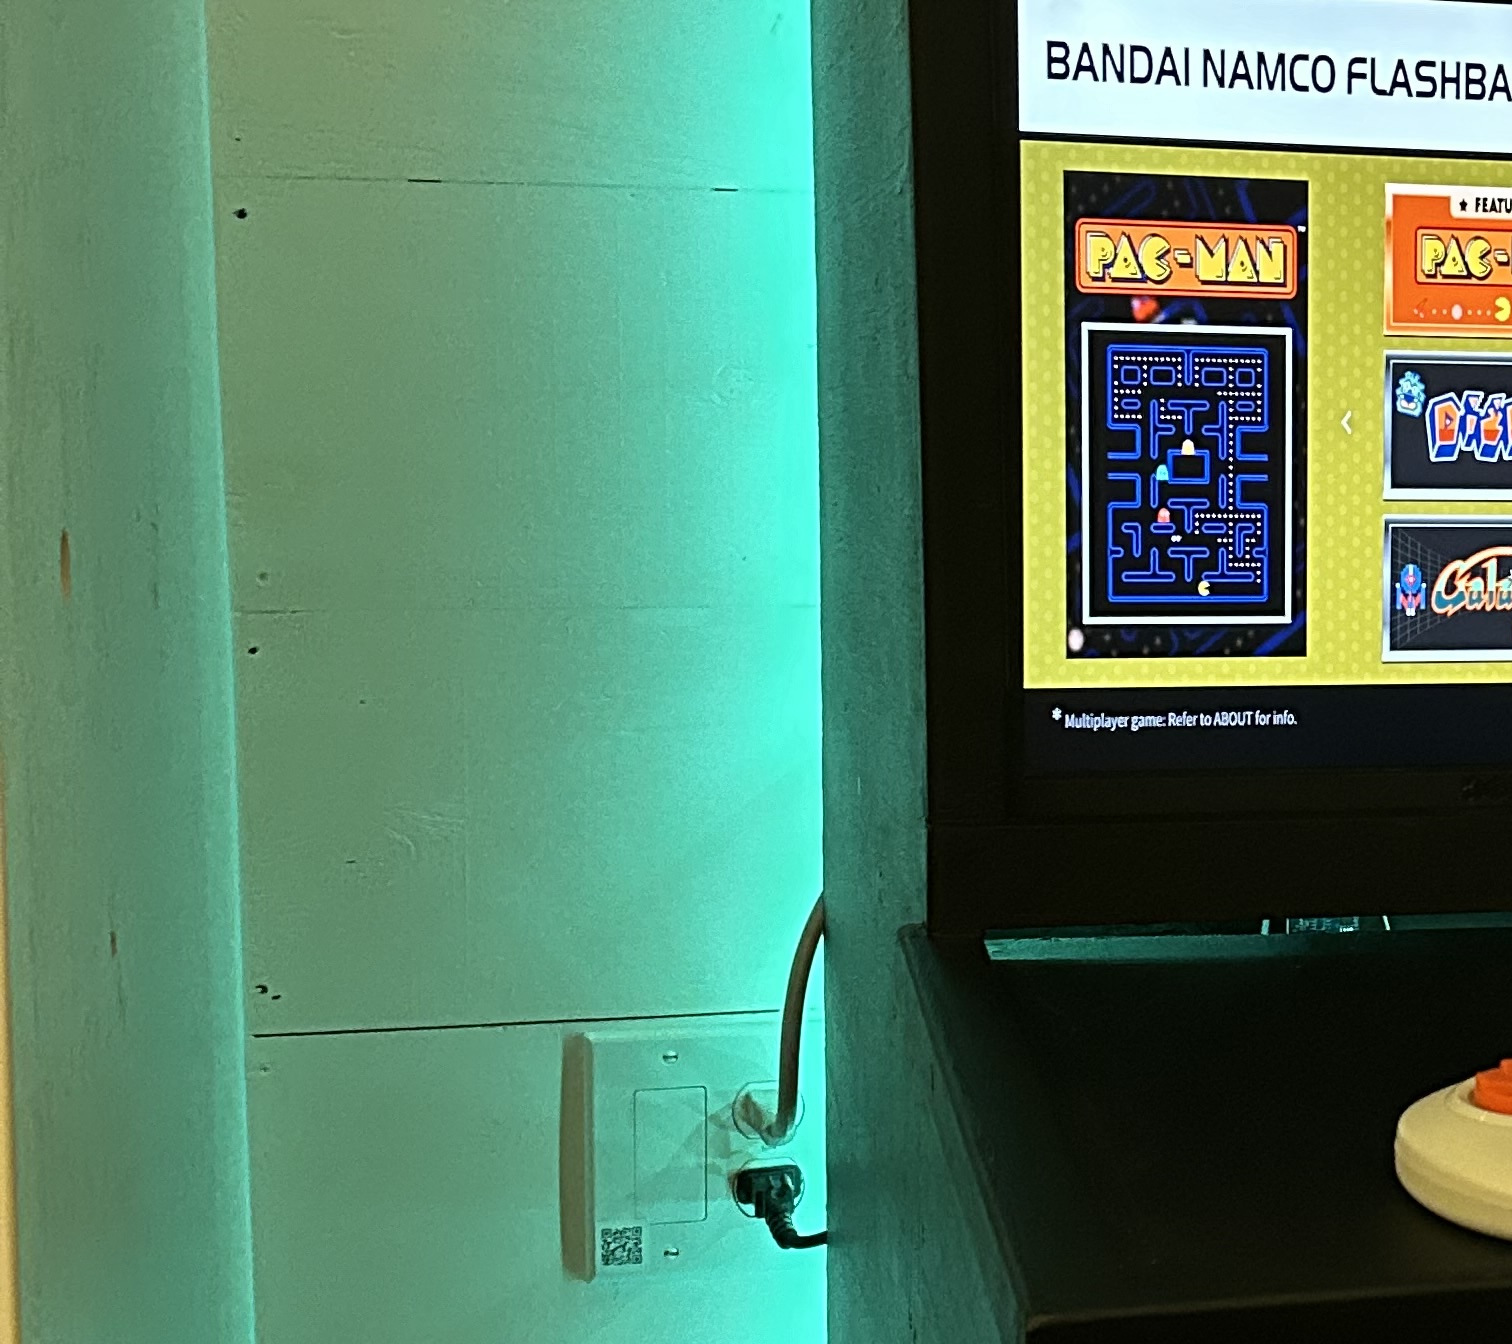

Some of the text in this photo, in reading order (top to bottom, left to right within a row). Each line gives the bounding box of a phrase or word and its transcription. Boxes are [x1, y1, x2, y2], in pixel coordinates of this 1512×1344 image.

[1046, 40, 1191, 87] BANDAI
[1202, 50, 1336, 94] NAMCO
[1086, 231, 1288, 285] PAC-MAN
[1064, 709, 1298, 732] Multiplayer game: Refer to ABOUT for info.
